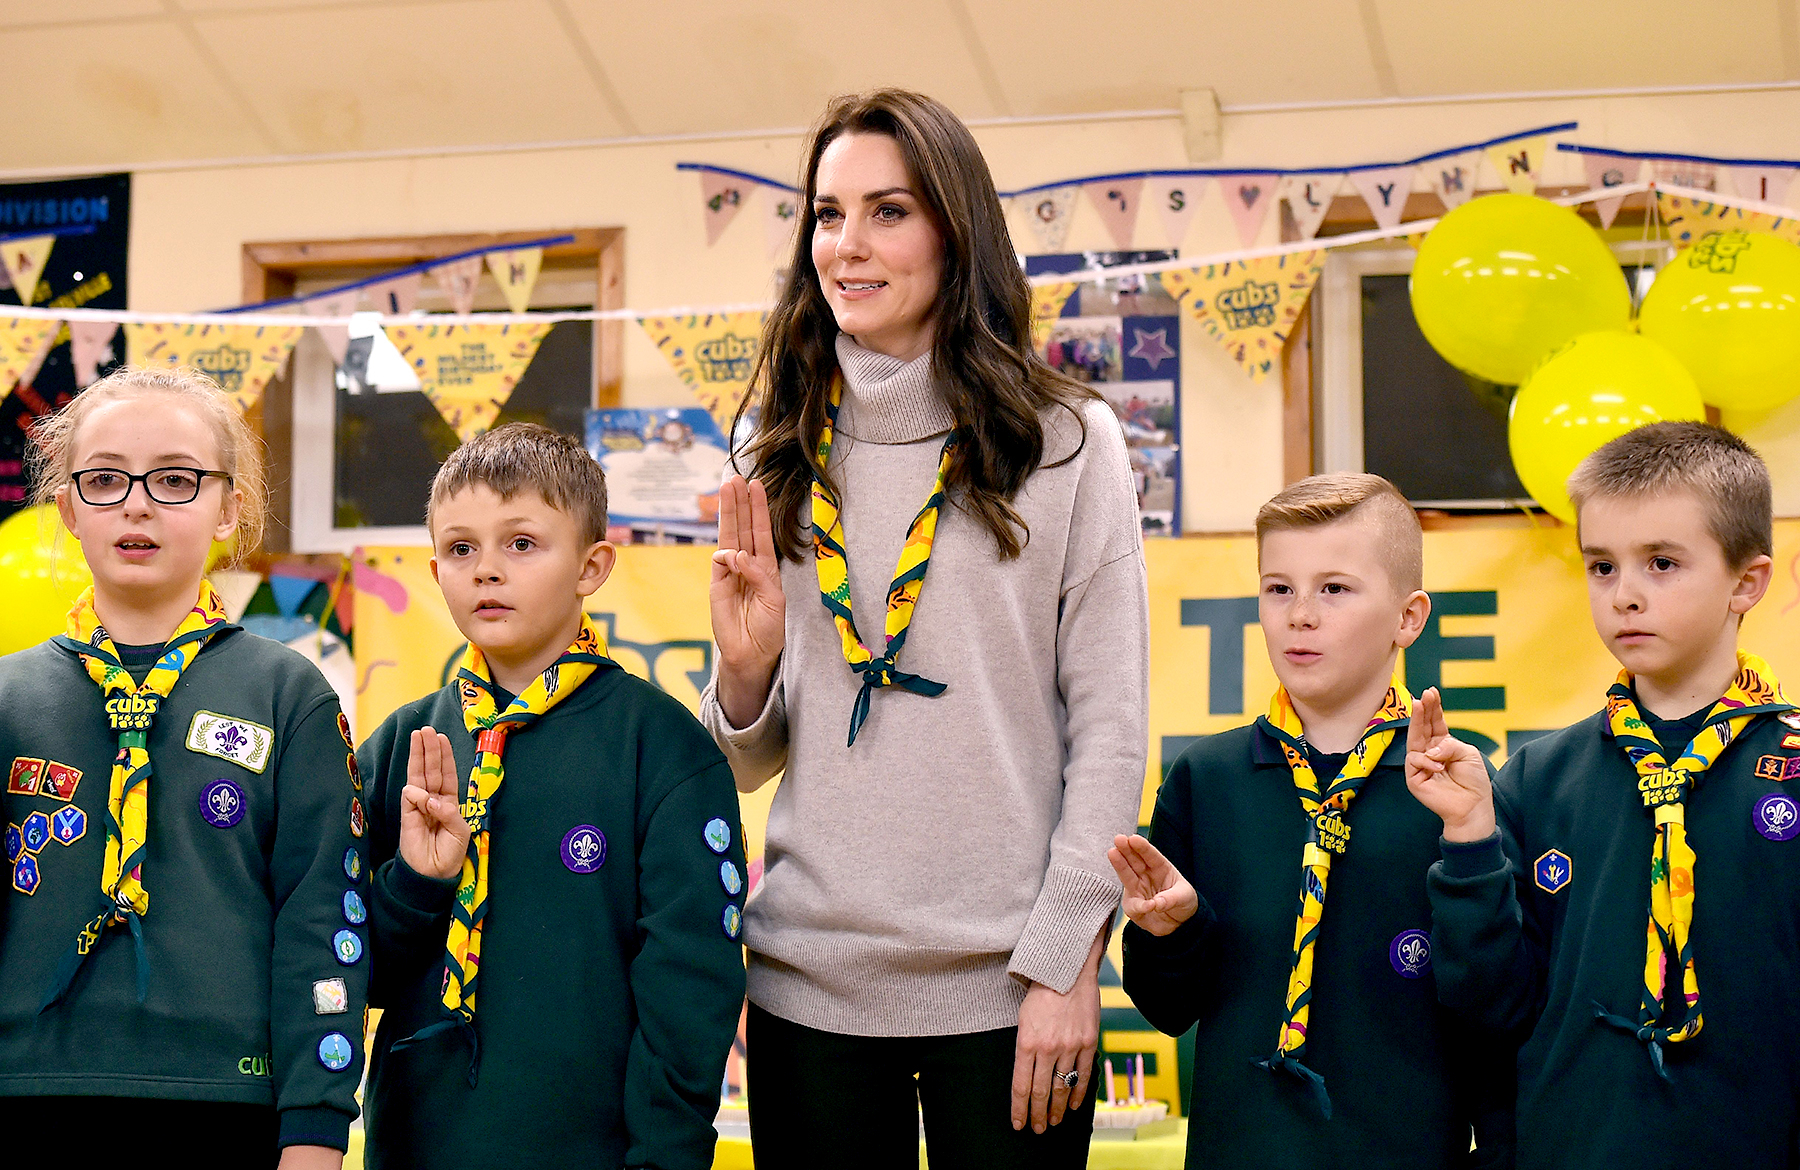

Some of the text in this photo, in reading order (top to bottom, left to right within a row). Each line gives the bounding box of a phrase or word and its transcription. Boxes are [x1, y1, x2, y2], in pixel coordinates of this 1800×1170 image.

[1215, 280, 1280, 313] cubs
[1180, 589, 1507, 716] TE
[105, 693, 158, 714] cubs
[215, 747, 239, 759] FORGET
[1638, 767, 1687, 792] cubs
[458, 797, 488, 819] ubs
[1316, 815, 1351, 841] cubs
